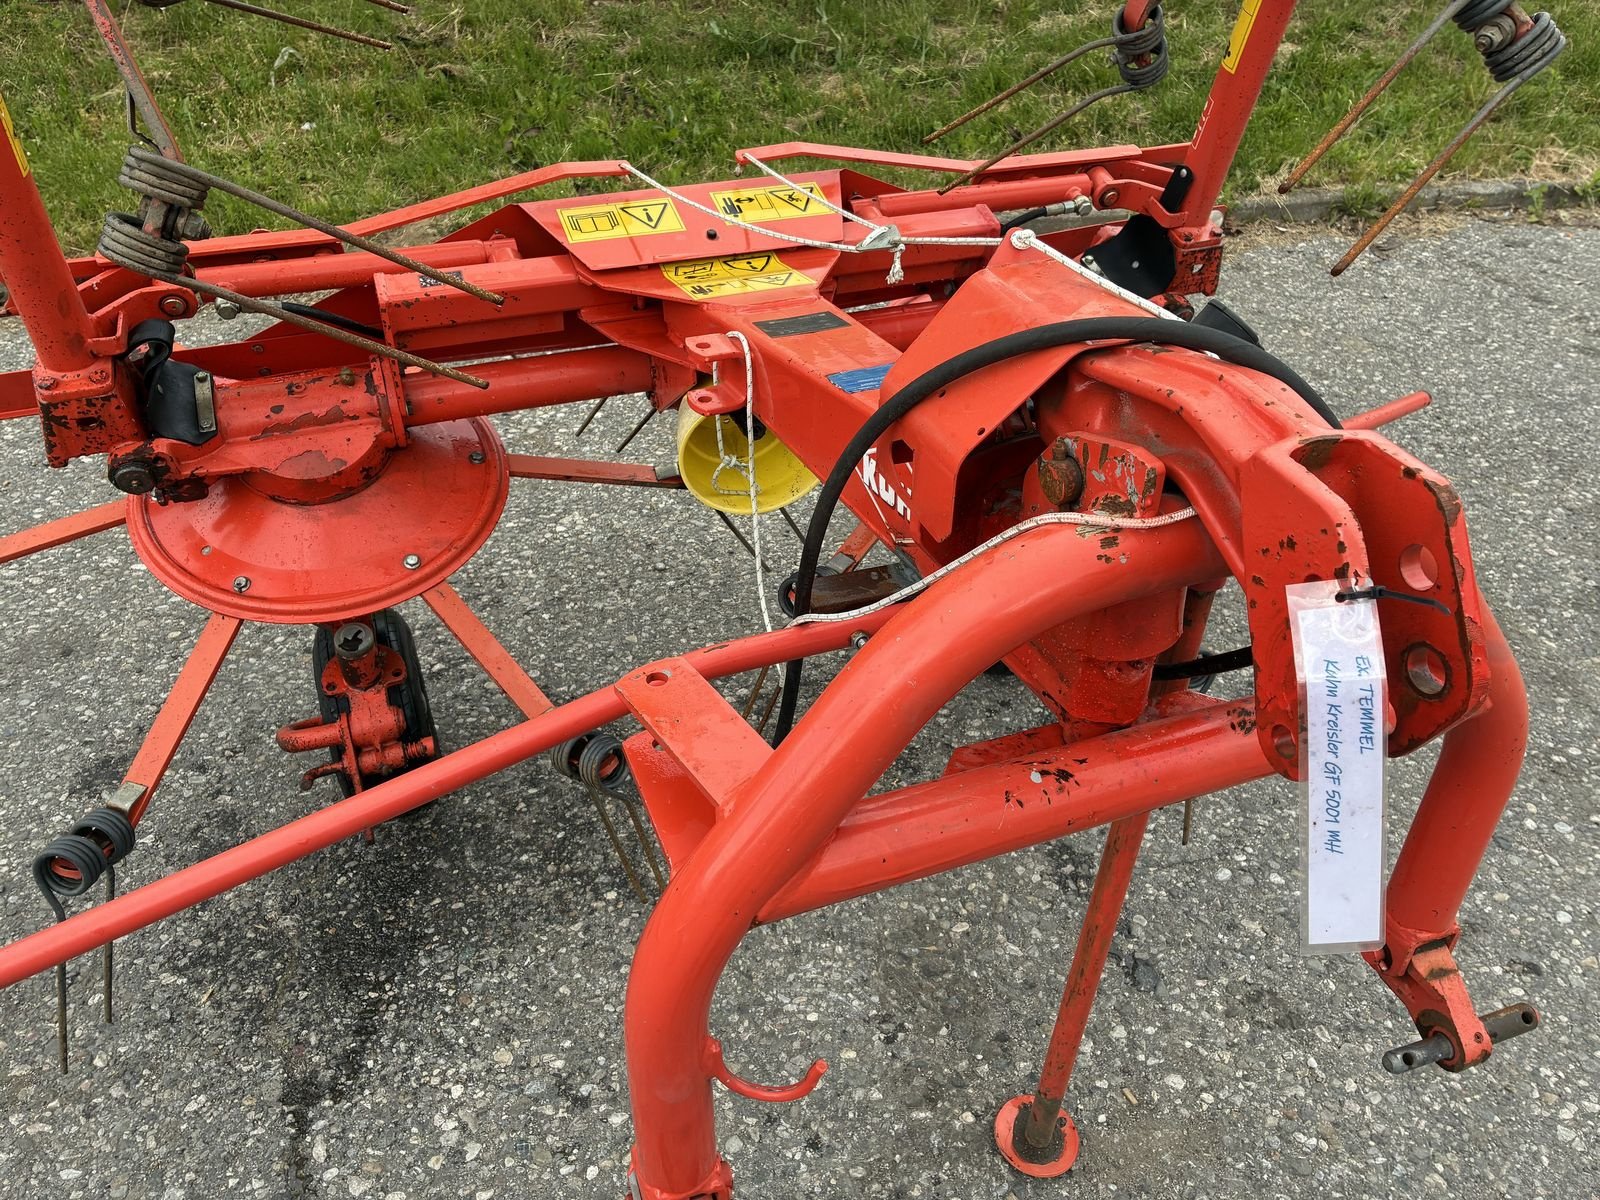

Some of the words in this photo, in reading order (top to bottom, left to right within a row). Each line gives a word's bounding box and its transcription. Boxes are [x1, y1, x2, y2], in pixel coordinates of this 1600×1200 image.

[1323, 659, 1341, 697] Kuhn
[1326, 703, 1343, 758] Kreisler
[1359, 683, 1375, 754] TEMMEL
[1323, 761, 1342, 785] GF
[1325, 789, 1341, 823] 5001
[1323, 829, 1344, 855] MH
